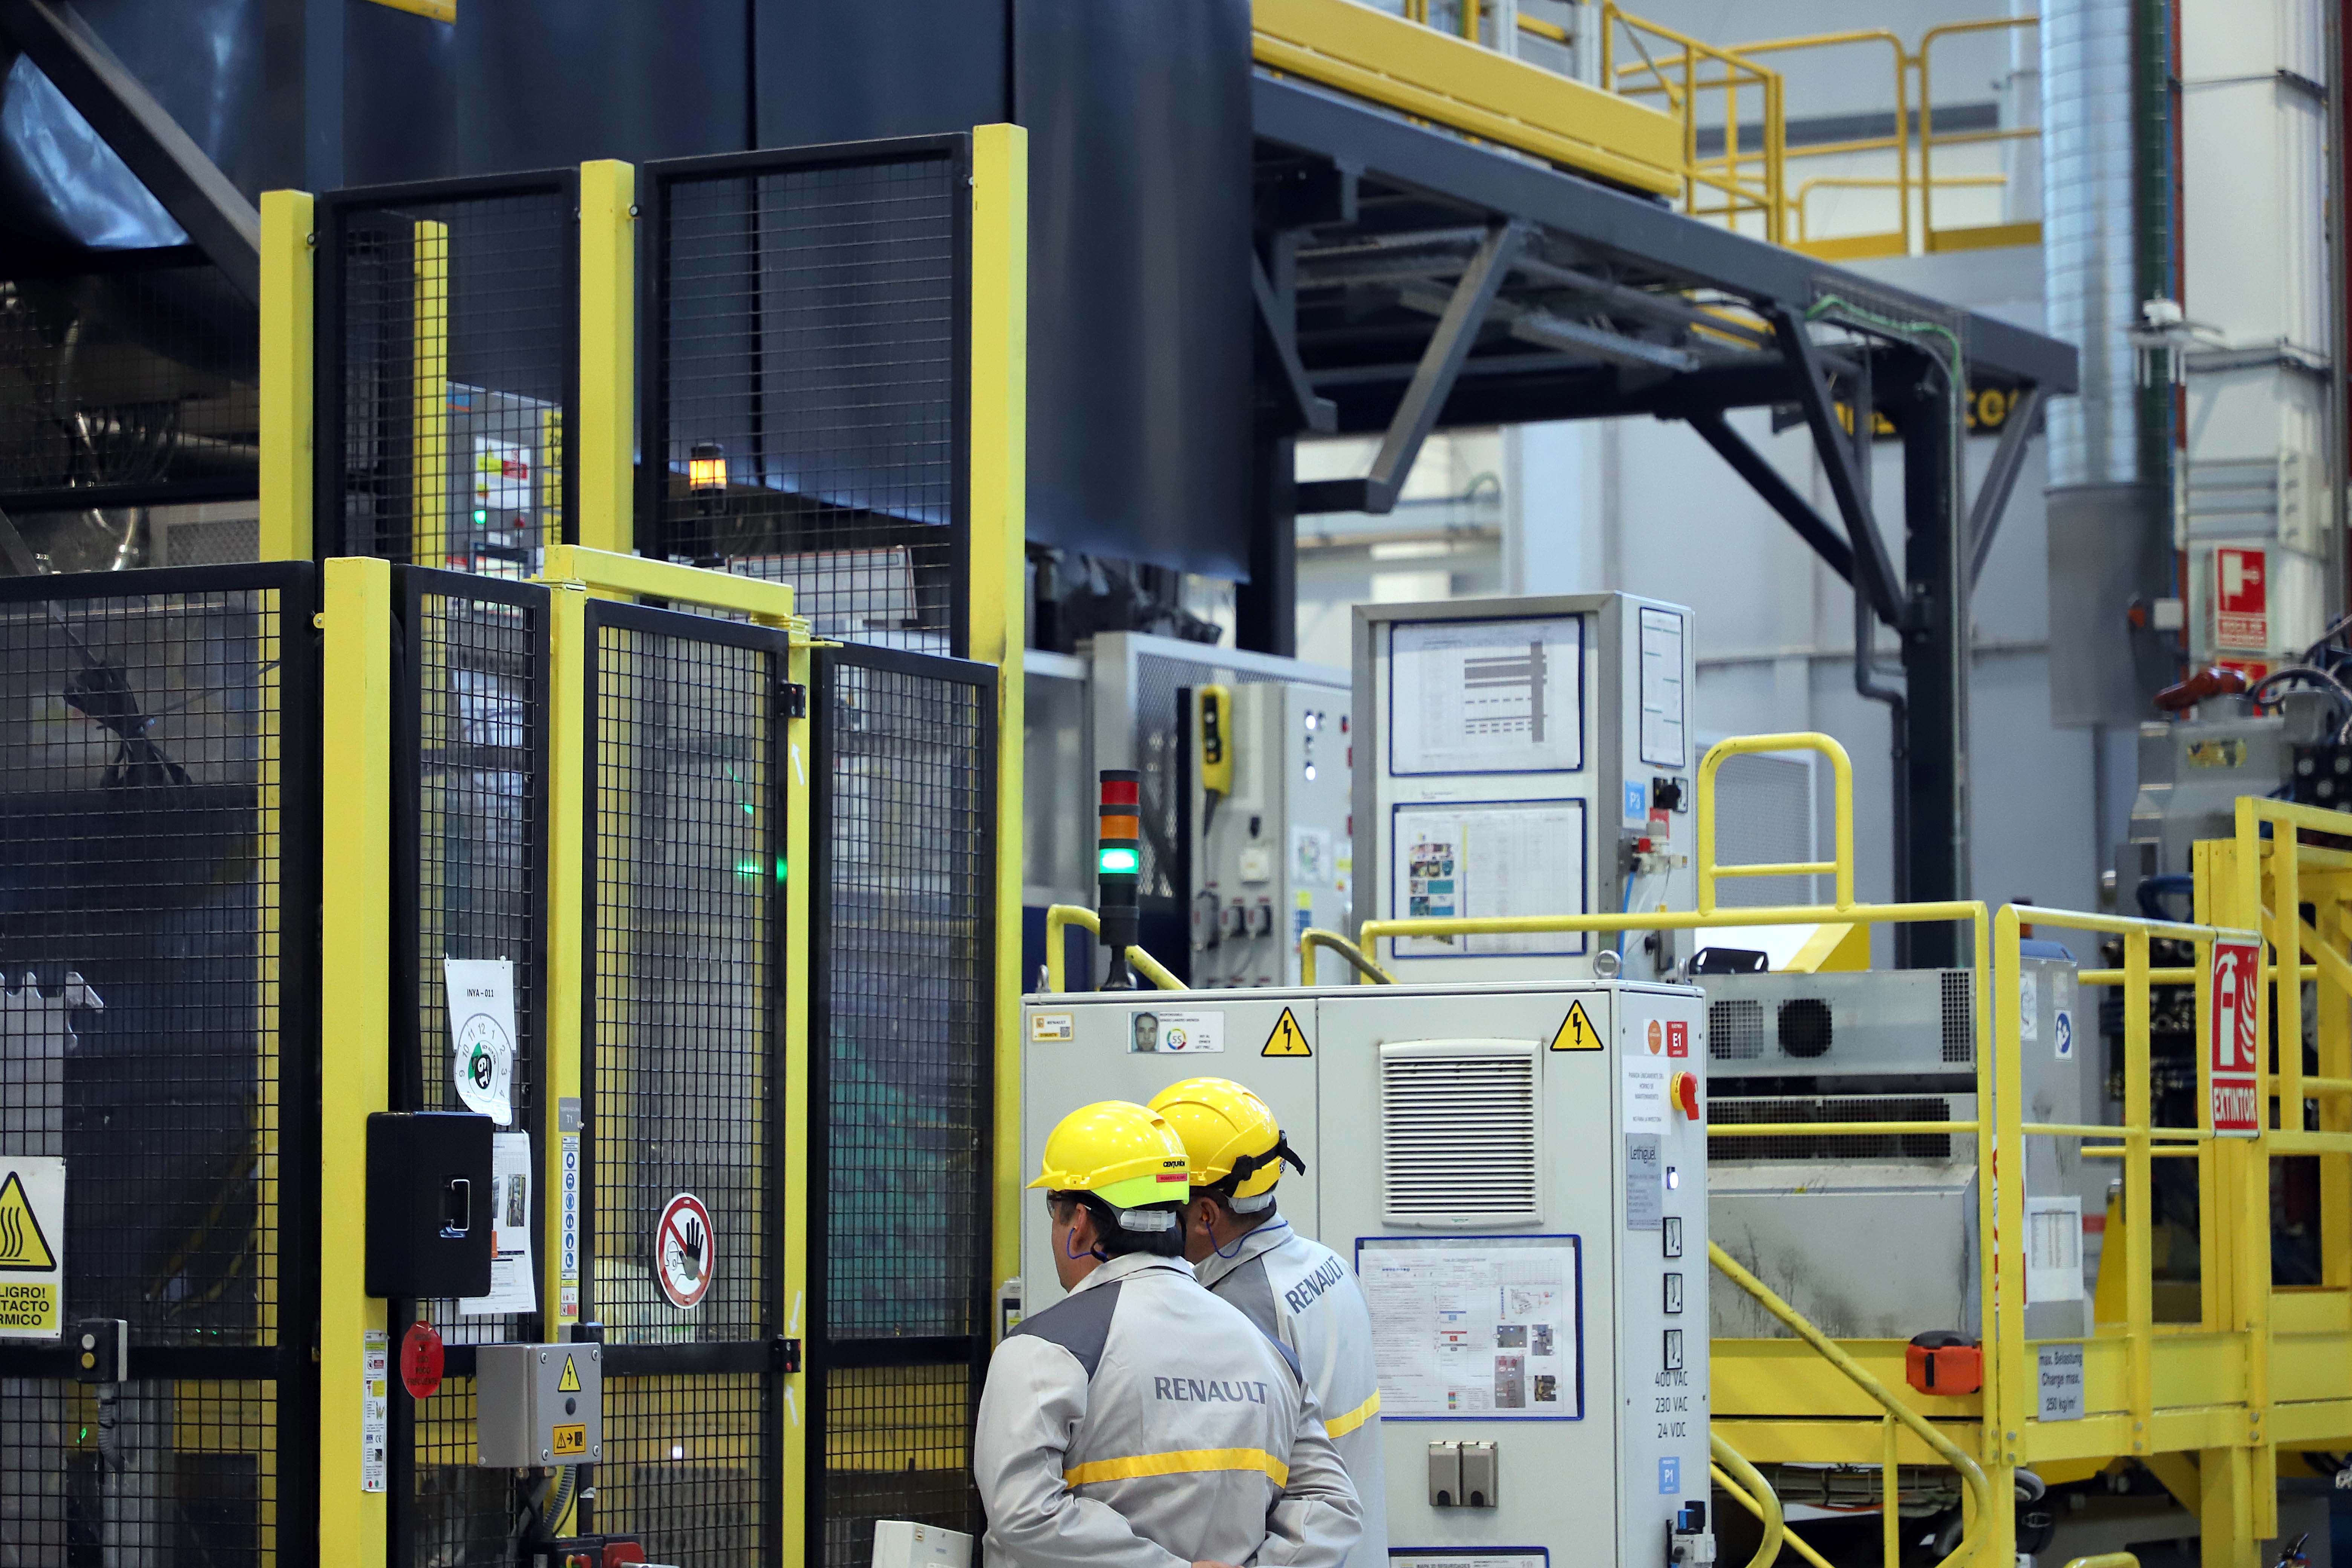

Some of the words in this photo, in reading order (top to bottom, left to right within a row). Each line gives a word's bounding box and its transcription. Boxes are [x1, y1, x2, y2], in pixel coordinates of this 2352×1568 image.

[467, 989, 479, 997] INYA
[485, 989, 494, 997] 011
[478, 1023, 485, 1035] 12
[1672, 1033, 1681, 1047] E1
[2214, 1087, 2256, 1122] EXTINTOR
[1285, 1255, 1343, 1314] RENAULT
[0, 1300, 49, 1312] TACTO
[1655, 1372, 1671, 1387] 400
[1673, 1371, 1688, 1386] VAC
[1154, 1377, 1267, 1404] RENAULT
[1655, 1397, 1671, 1413] 230
[1673, 1396, 1688, 1412] VAC
[1658, 1423, 1668, 1438] 24
[1671, 1422, 1686, 1438] VDC
[1664, 1469, 1673, 1484] P1
